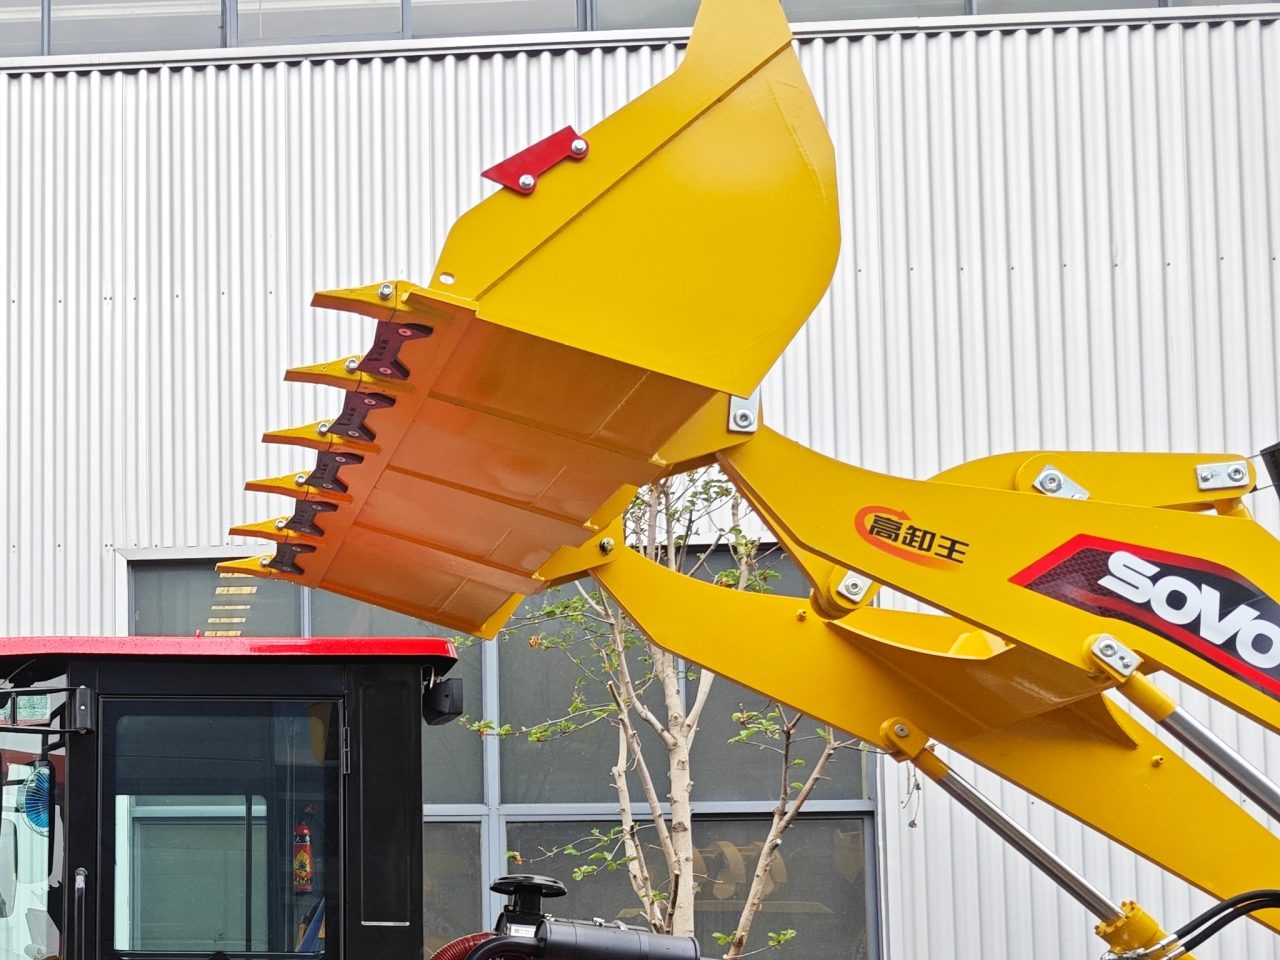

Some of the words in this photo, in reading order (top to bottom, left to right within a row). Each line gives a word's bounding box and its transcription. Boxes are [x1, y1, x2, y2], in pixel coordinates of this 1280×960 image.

[869, 514, 970, 564] 高卸王
[1097, 551, 1280, 669] SOVO
